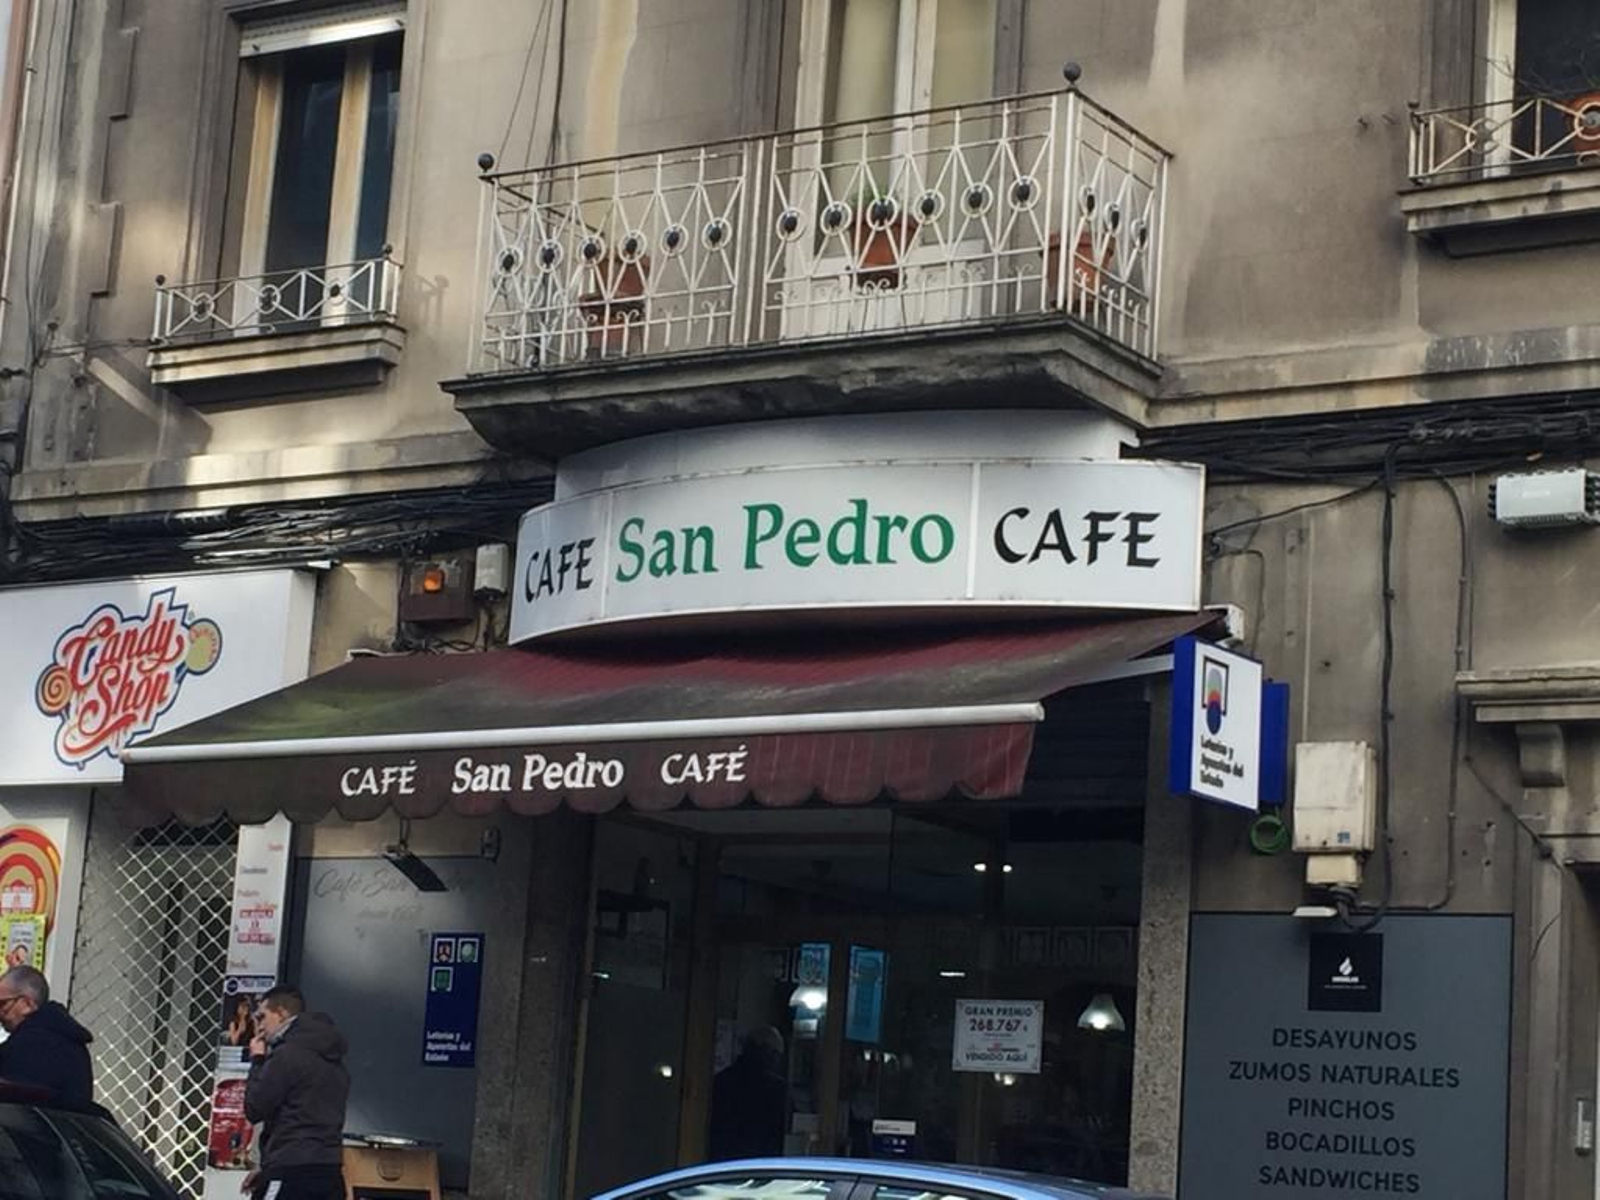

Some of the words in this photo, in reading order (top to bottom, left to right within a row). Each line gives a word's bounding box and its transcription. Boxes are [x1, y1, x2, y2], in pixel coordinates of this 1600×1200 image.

[525, 536, 597, 603] CAFE
[616, 517, 719, 583] San
[743, 498, 956, 570] Pedro
[994, 507, 1162, 568] CAFE
[62, 602, 185, 692] Candy
[77, 662, 171, 738] Shop
[340, 759, 418, 797] CAFÉ
[451, 757, 512, 794] San
[522, 752, 625, 791] Pedro
[660, 744, 749, 786] CAFÉ
[1272, 1028, 1417, 1051] DESAYUNOS
[1229, 1061, 1311, 1083] ZUMOS
[1321, 1064, 1460, 1088] NATURALES
[1288, 1098, 1395, 1120] PINCHOS
[1266, 1131, 1416, 1157] BOCADILLOS
[1259, 1165, 1421, 1193] SANDWICHES
